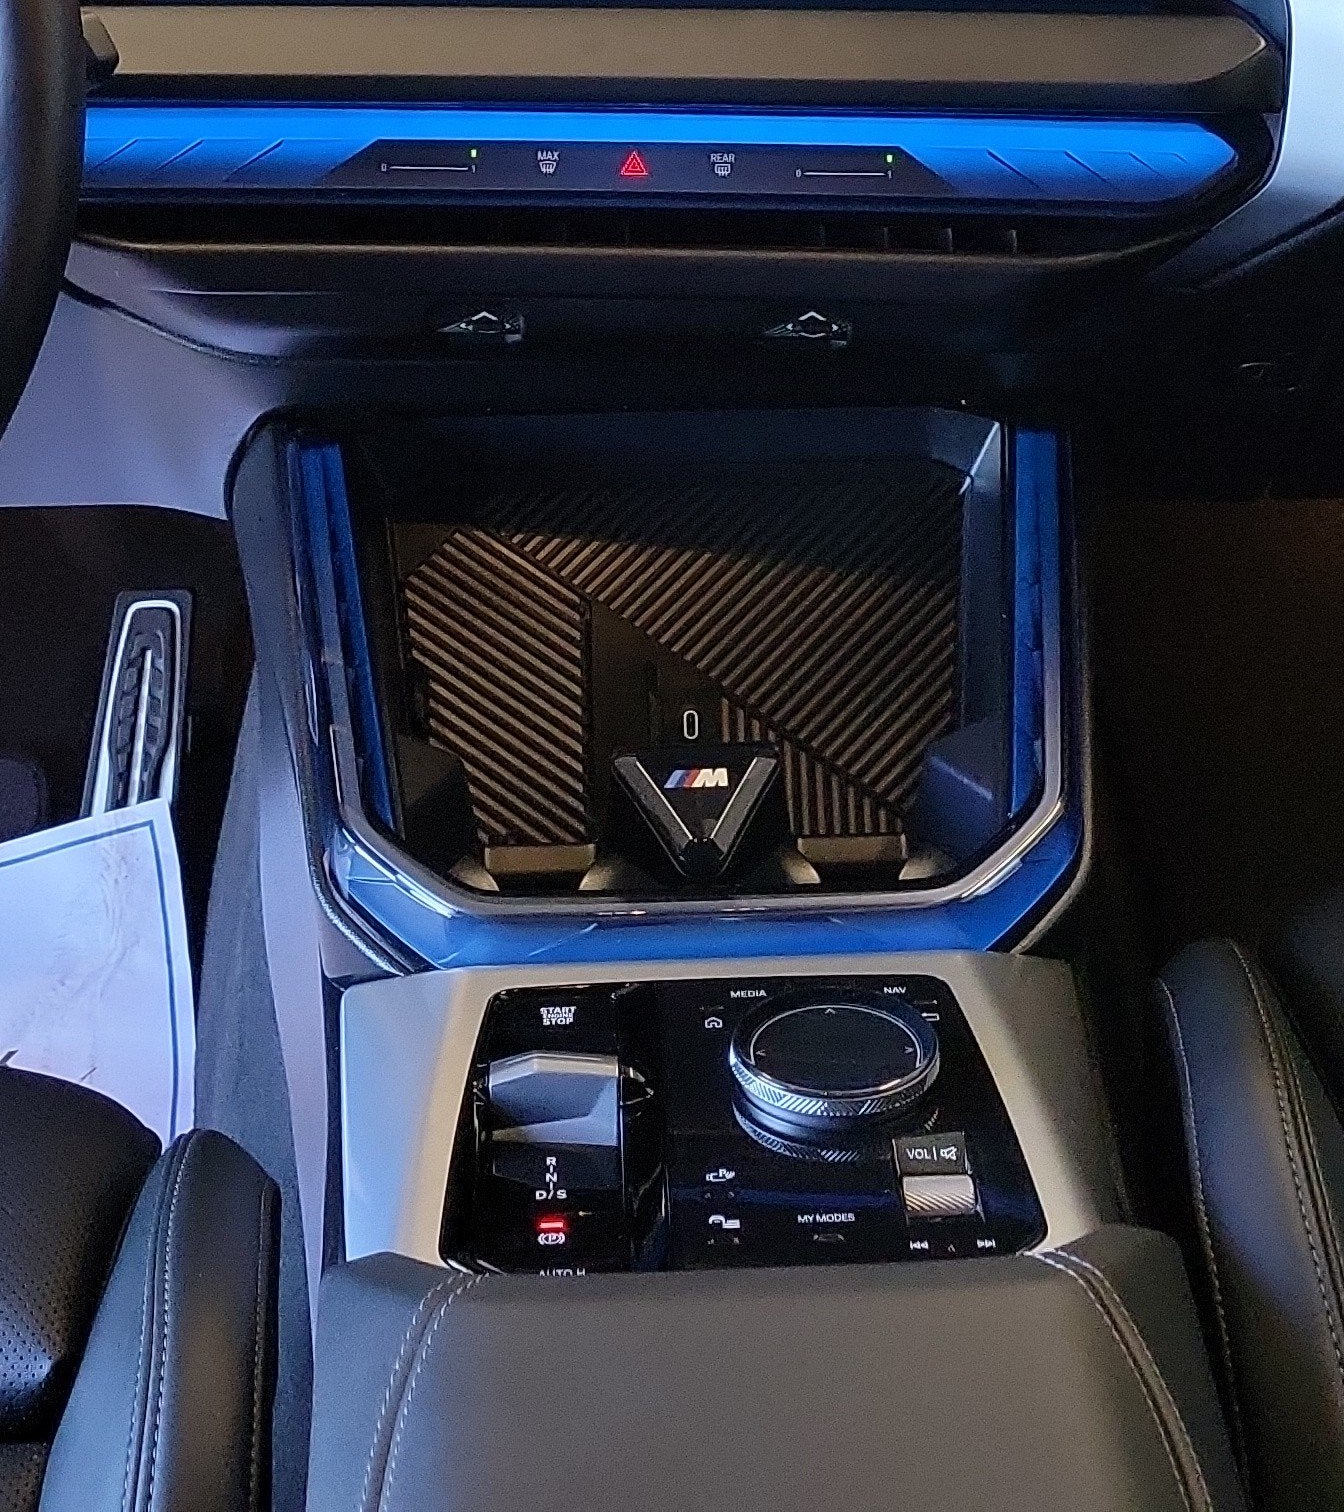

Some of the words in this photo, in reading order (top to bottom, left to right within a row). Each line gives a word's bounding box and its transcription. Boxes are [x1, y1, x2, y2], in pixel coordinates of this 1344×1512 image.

[537, 150, 560, 161] MAX
[710, 153, 736, 163] REAR
[730, 988, 768, 999] MEDIA
[883, 986, 907, 995] NAV
[540, 1006, 576, 1014] START
[543, 1018, 574, 1026] STOP
[906, 1147, 931, 1160] VOL
[546, 1156, 557, 1166] R
[545, 1172, 558, 1183] N
[797, 1213, 814, 1224] MY
[816, 1212, 856, 1223] MODES
